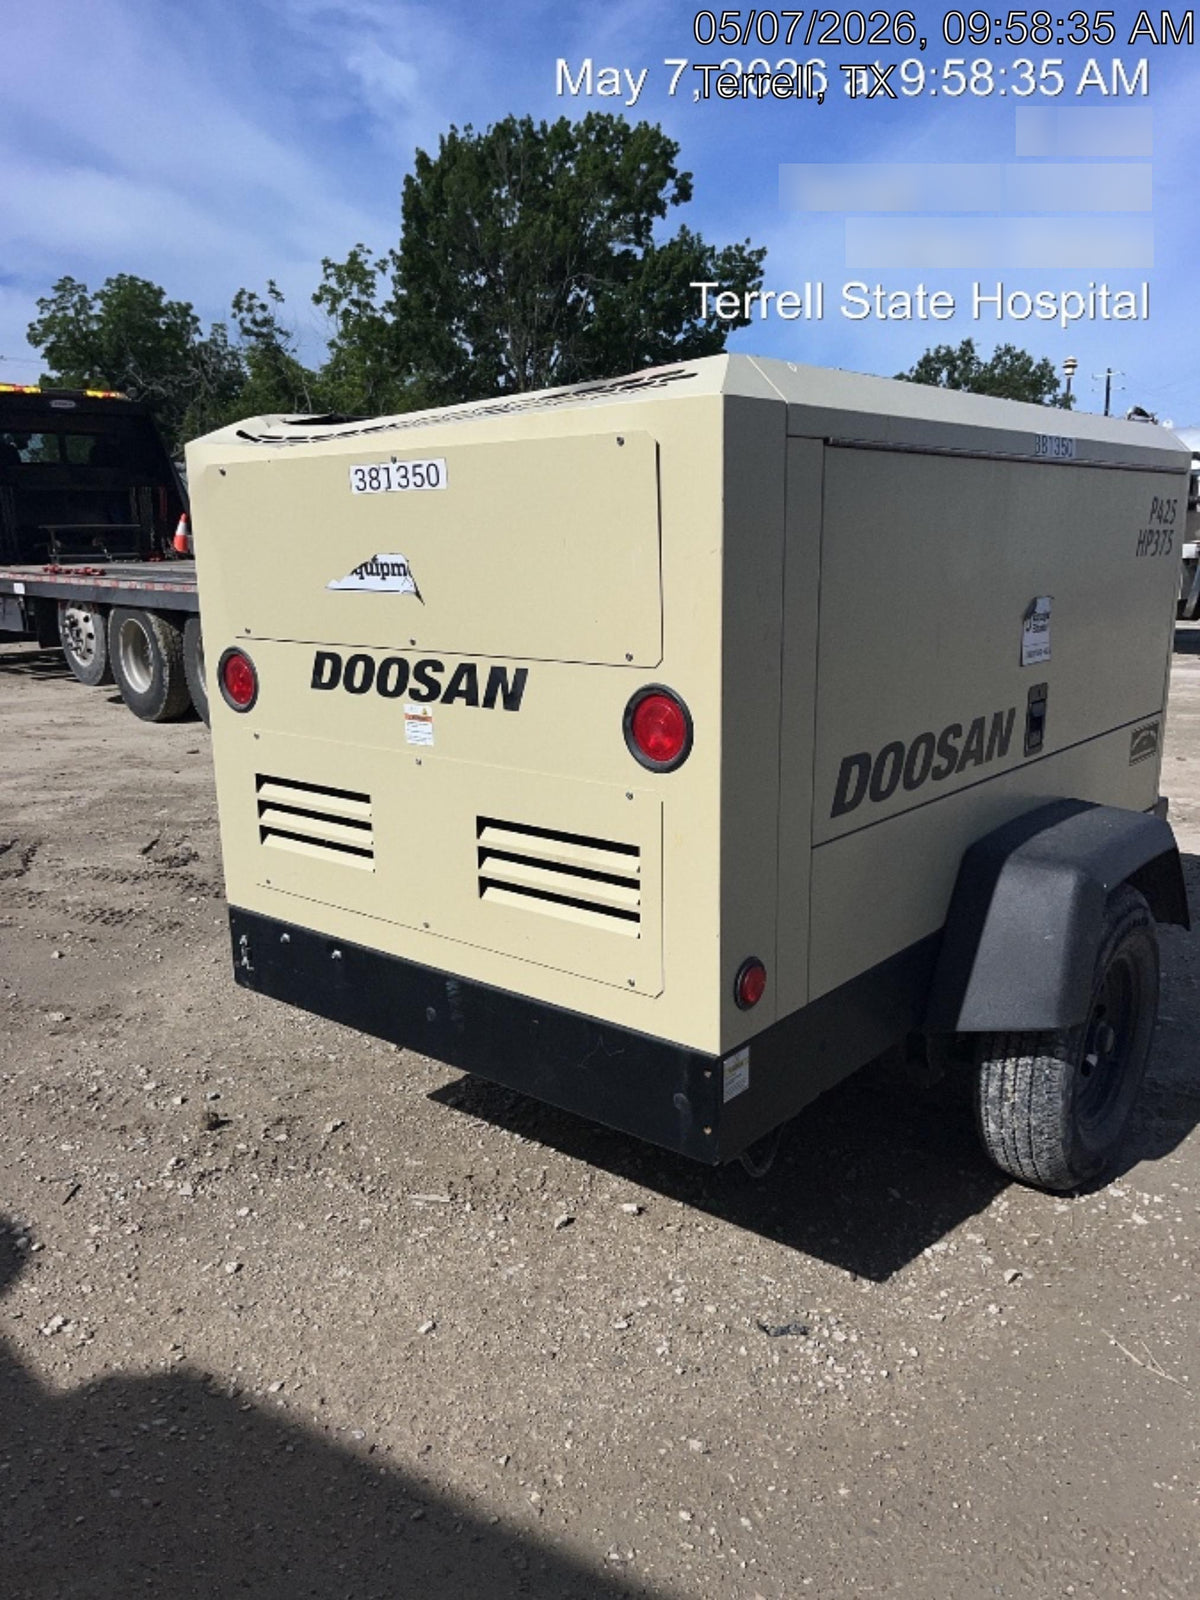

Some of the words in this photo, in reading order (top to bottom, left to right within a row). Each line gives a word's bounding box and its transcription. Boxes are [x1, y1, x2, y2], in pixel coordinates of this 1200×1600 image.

[354, 462, 441, 492] 381350
[311, 651, 528, 712] DOOSAN
[830, 707, 1016, 819] DOOSAN
